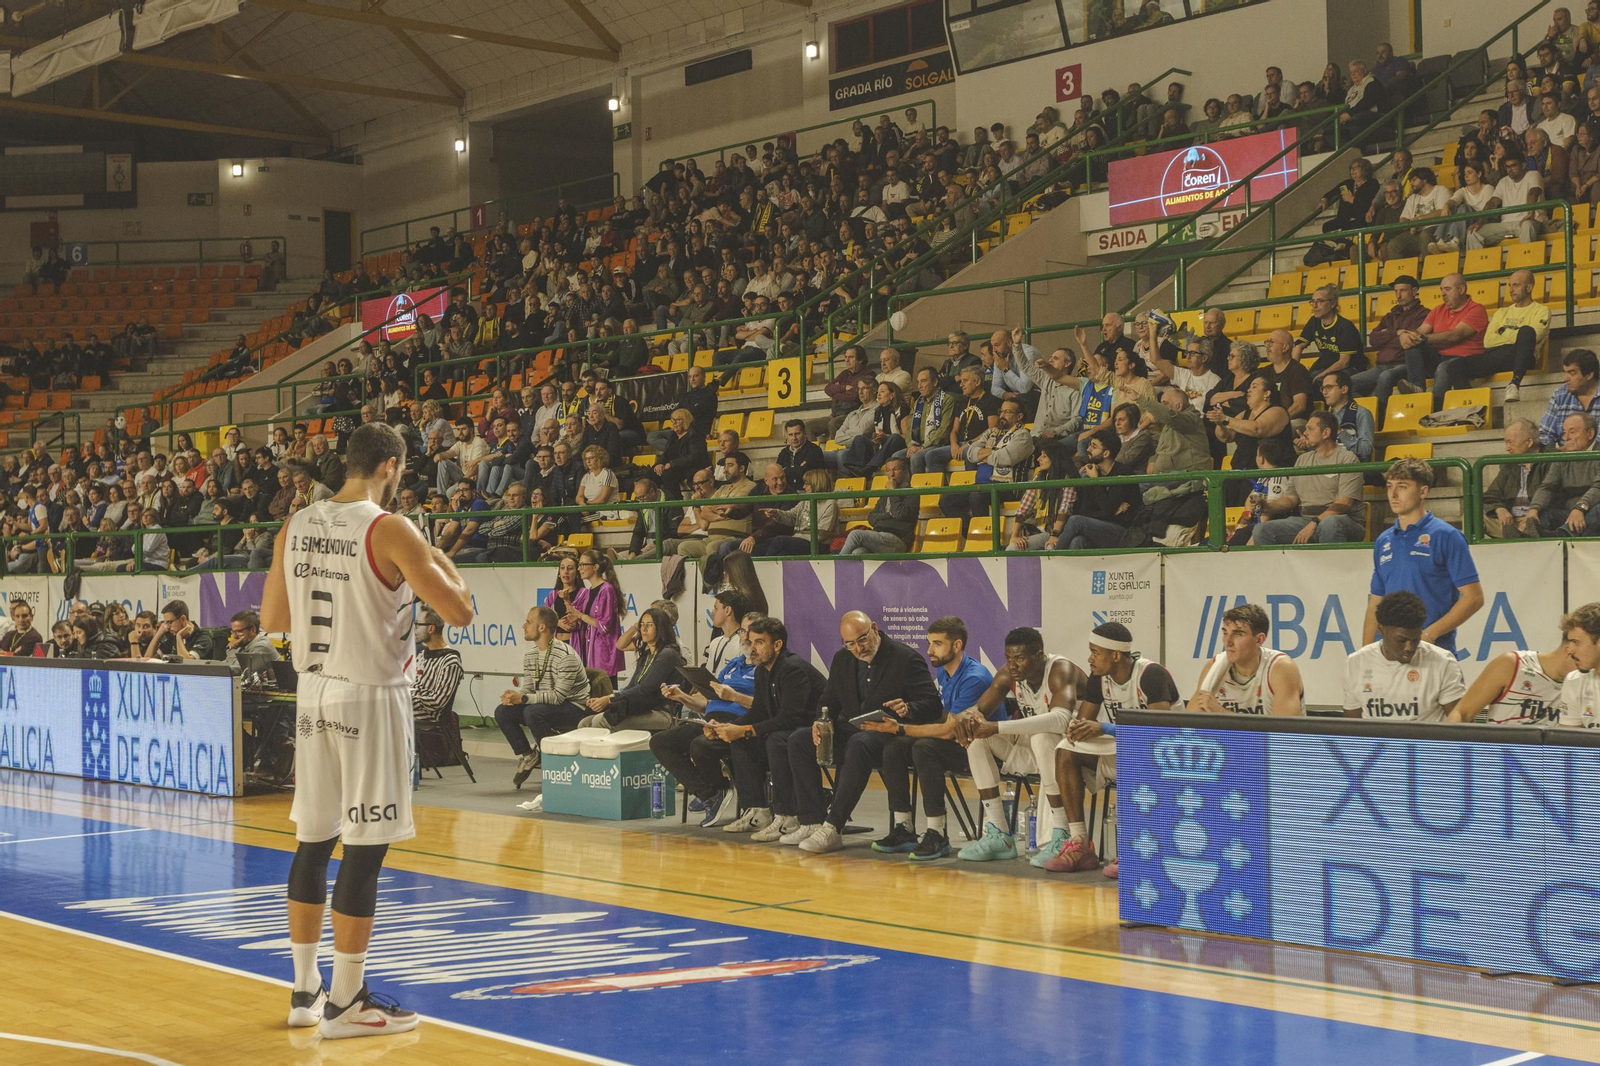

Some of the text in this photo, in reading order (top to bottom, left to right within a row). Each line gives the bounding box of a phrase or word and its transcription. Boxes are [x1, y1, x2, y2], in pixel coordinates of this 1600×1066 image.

[835, 73, 893, 100] GRADA RÍO
[905, 68, 956, 90] SOLGAL
[1062, 71, 1075, 96] 3
[1165, 192, 1203, 206] ALIMENTOS
[476, 208, 483, 226] 1
[1099, 228, 1148, 250] SAIDA
[71, 246, 83, 262] 6
[777, 367, 792, 399] 3
[1086, 412, 1098, 422] 32
[1107, 580, 1151, 591] DE GALICIA
[1108, 571, 1135, 581] XUNTA
[9, 591, 40, 603] DEPORTE
[447, 623, 517, 646] GALICIA
[117, 672, 184, 724] XUNTA
[1366, 696, 1419, 718] fibwi
[117, 735, 230, 795] DE GALICIA
[543, 767, 572, 784] ingade
[582, 771, 612, 788] ingade
[622, 769, 654, 789] ingad
[348, 803, 398, 824] alsa
[1322, 860, 1468, 964] DE
